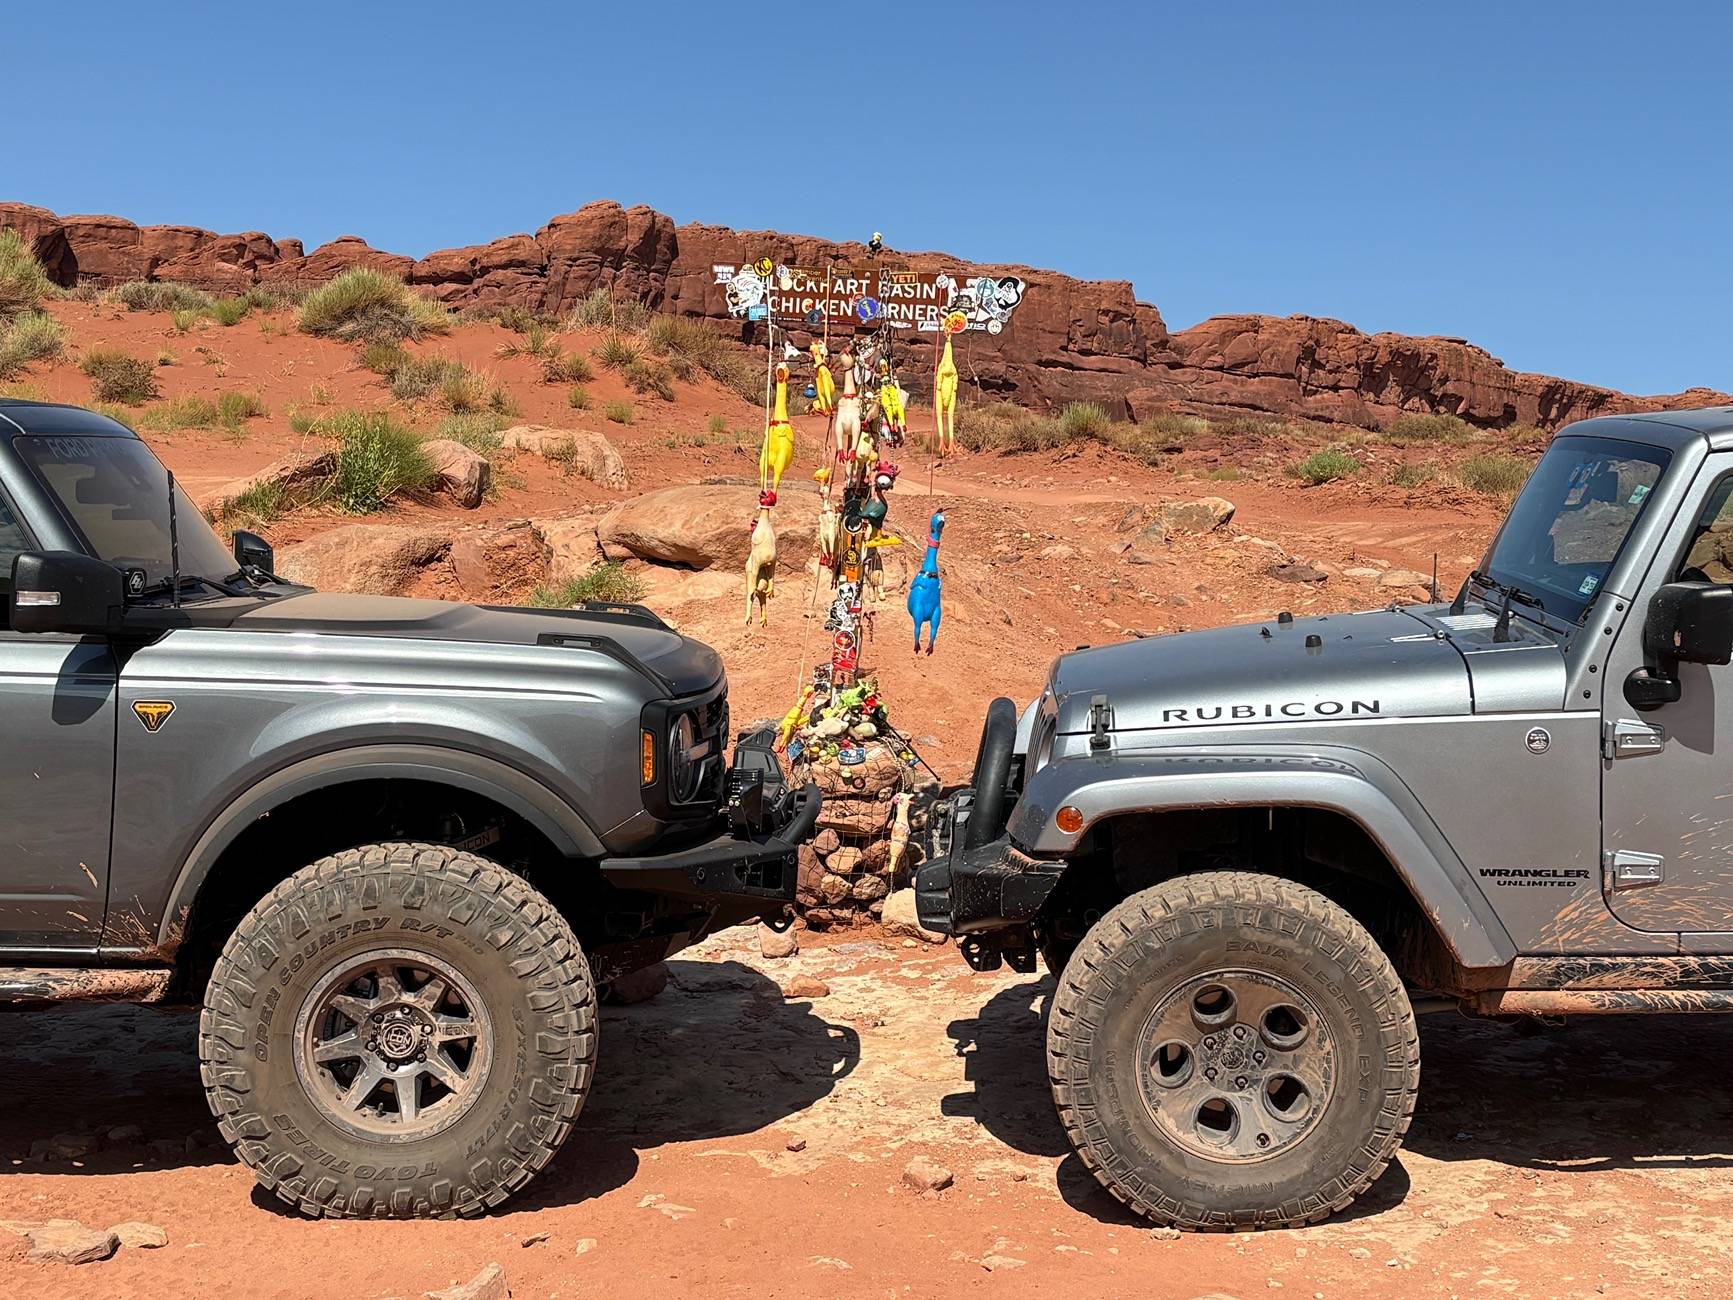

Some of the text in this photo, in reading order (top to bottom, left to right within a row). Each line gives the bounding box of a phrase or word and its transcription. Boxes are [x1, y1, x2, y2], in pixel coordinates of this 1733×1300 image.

[891, 274, 916, 283] YETI
[769, 296, 853, 316] CHICKEN
[1162, 700, 1380, 722] RUBICON
[1479, 868, 1590, 879] WRANGLER
[255, 986, 281, 1062] OPEN
[279, 917, 391, 985] COUNTRY
[399, 918, 455, 938] R/T
[1226, 941, 1371, 1104] BAJA LEGEND EXP
[273, 1114, 438, 1181] TOYO TIRES
